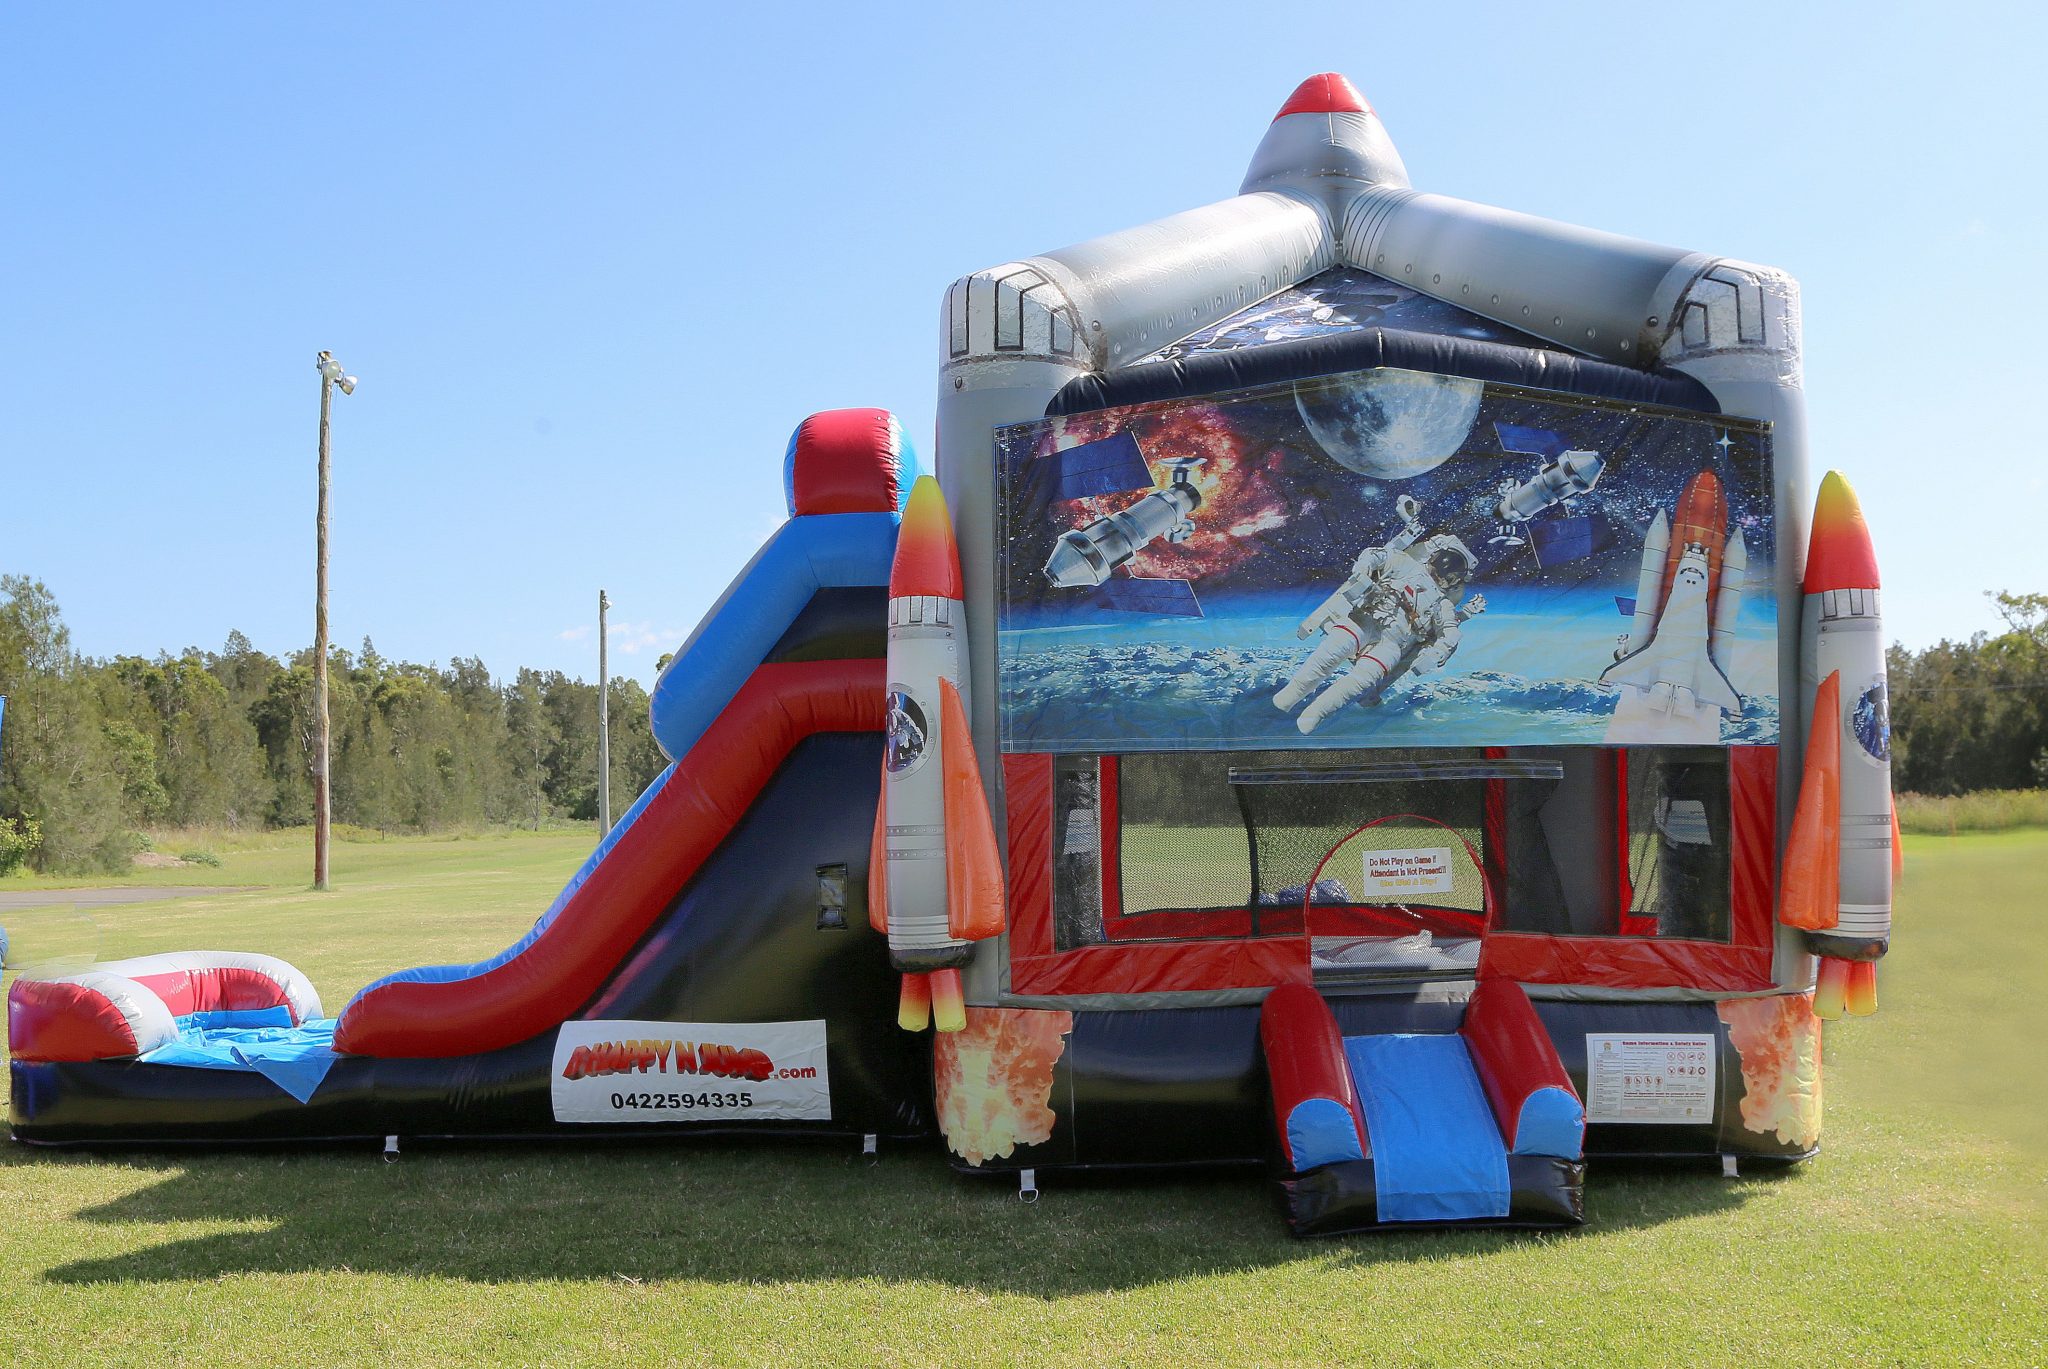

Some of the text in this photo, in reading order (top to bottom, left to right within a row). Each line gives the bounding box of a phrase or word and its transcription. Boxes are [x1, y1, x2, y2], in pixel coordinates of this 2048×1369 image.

[1369, 858, 1378, 866] Do
[1379, 857, 1390, 866] Not
[1391, 857, 1404, 866] Play
[1414, 856, 1431, 864] Game
[1370, 868, 1399, 877] Attendant
[1407, 867, 1417, 876] Not
[611, 1092, 753, 1109] 0422594335
